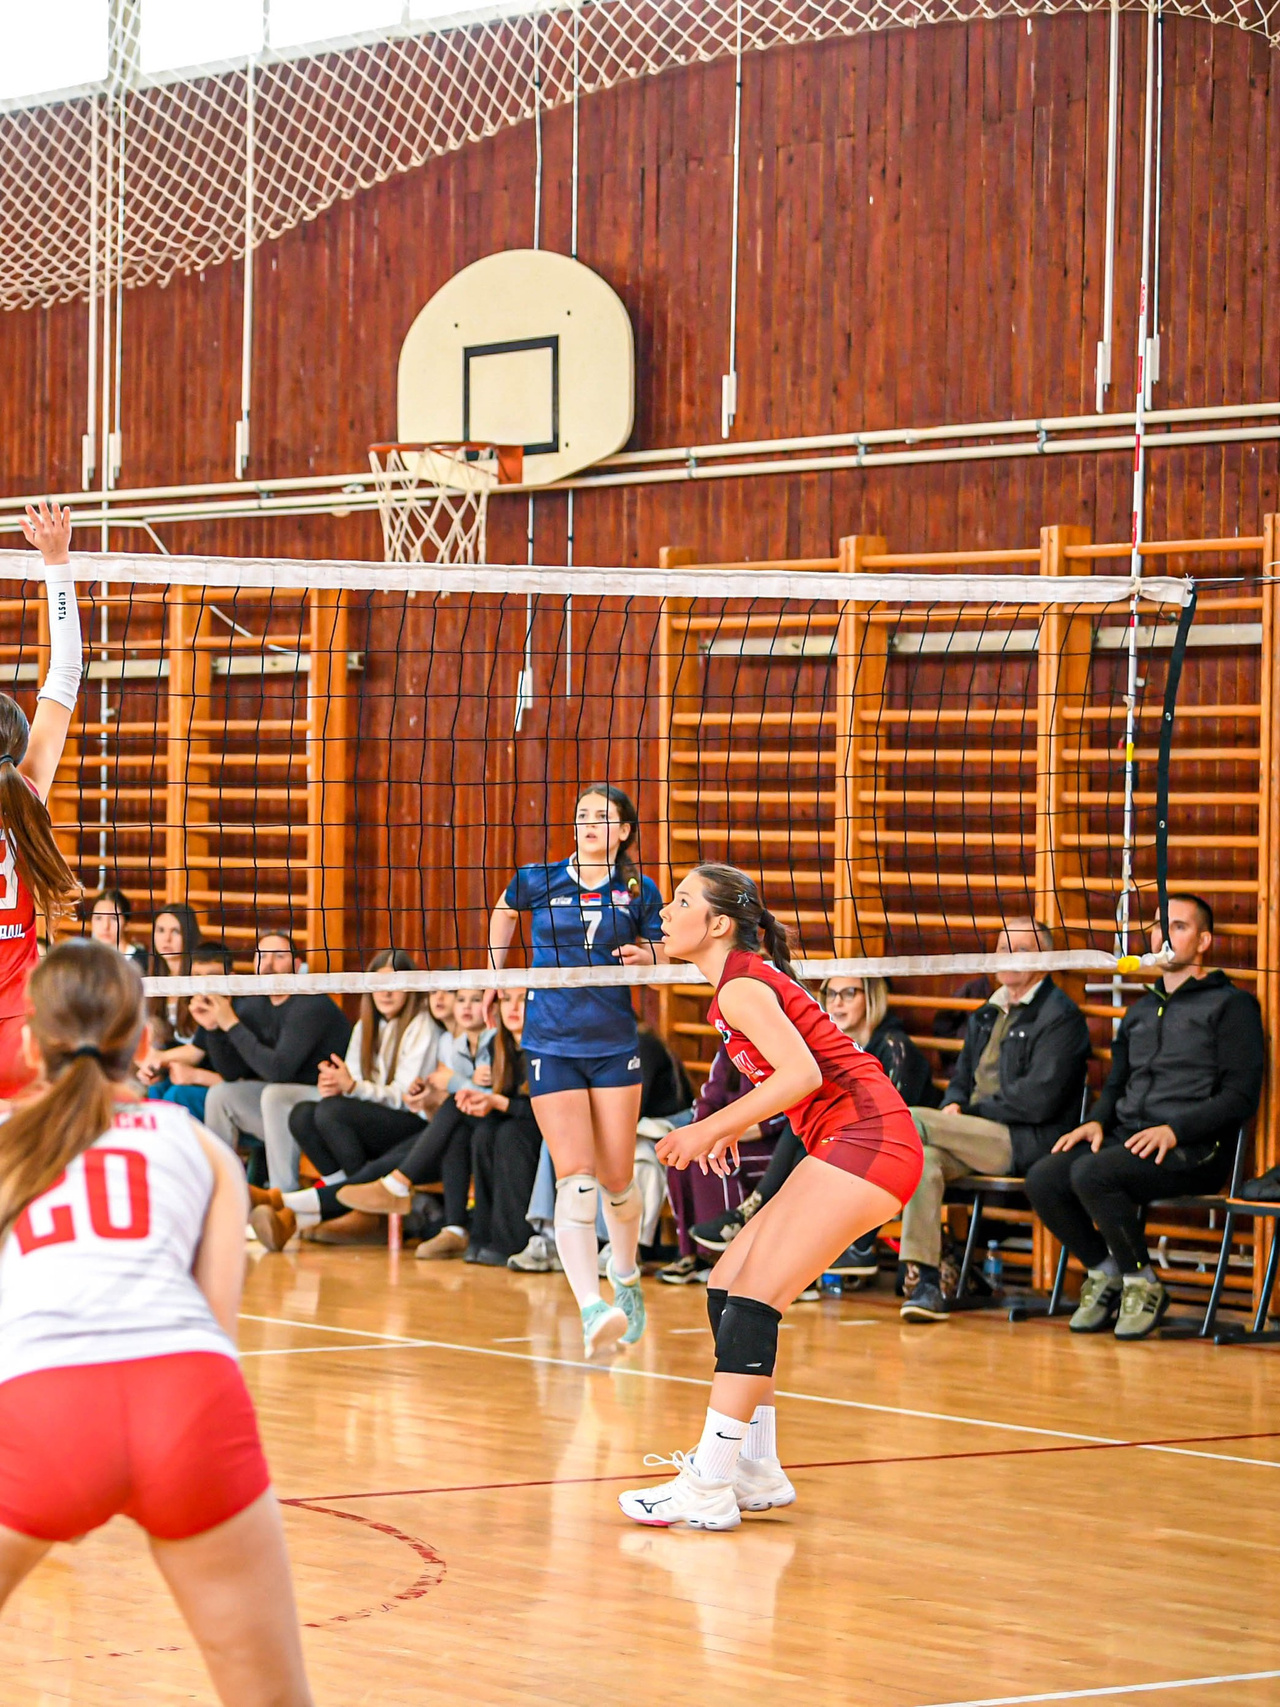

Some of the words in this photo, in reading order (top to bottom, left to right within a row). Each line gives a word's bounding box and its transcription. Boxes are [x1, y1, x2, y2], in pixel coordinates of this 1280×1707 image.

[58, 592, 66, 620] KIPSTA
[580, 910, 603, 950] 7
[531, 1059, 541, 1081] 7
[12, 1147, 151, 1257] 20
